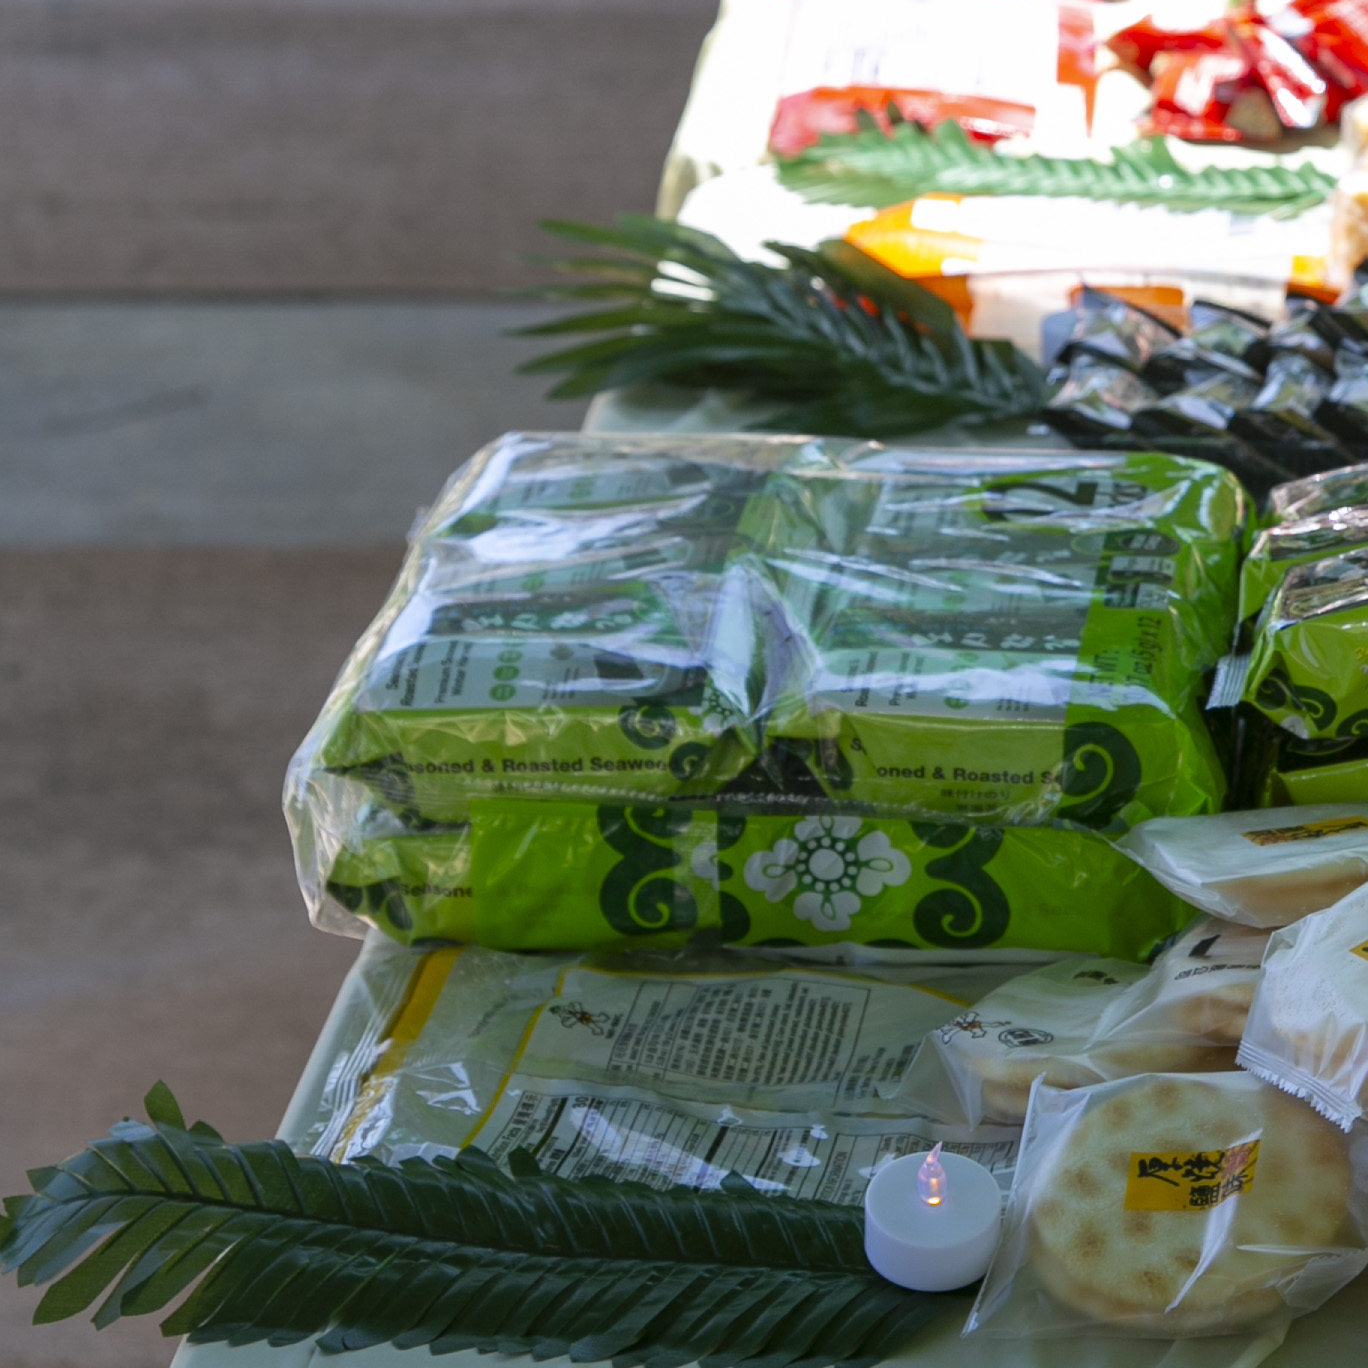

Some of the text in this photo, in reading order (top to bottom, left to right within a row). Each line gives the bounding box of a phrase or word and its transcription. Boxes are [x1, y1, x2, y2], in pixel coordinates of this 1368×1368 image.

[503, 757, 583, 774] Roasted
[589, 756, 670, 774] Seawee
[953, 766, 1034, 785] Roasted
